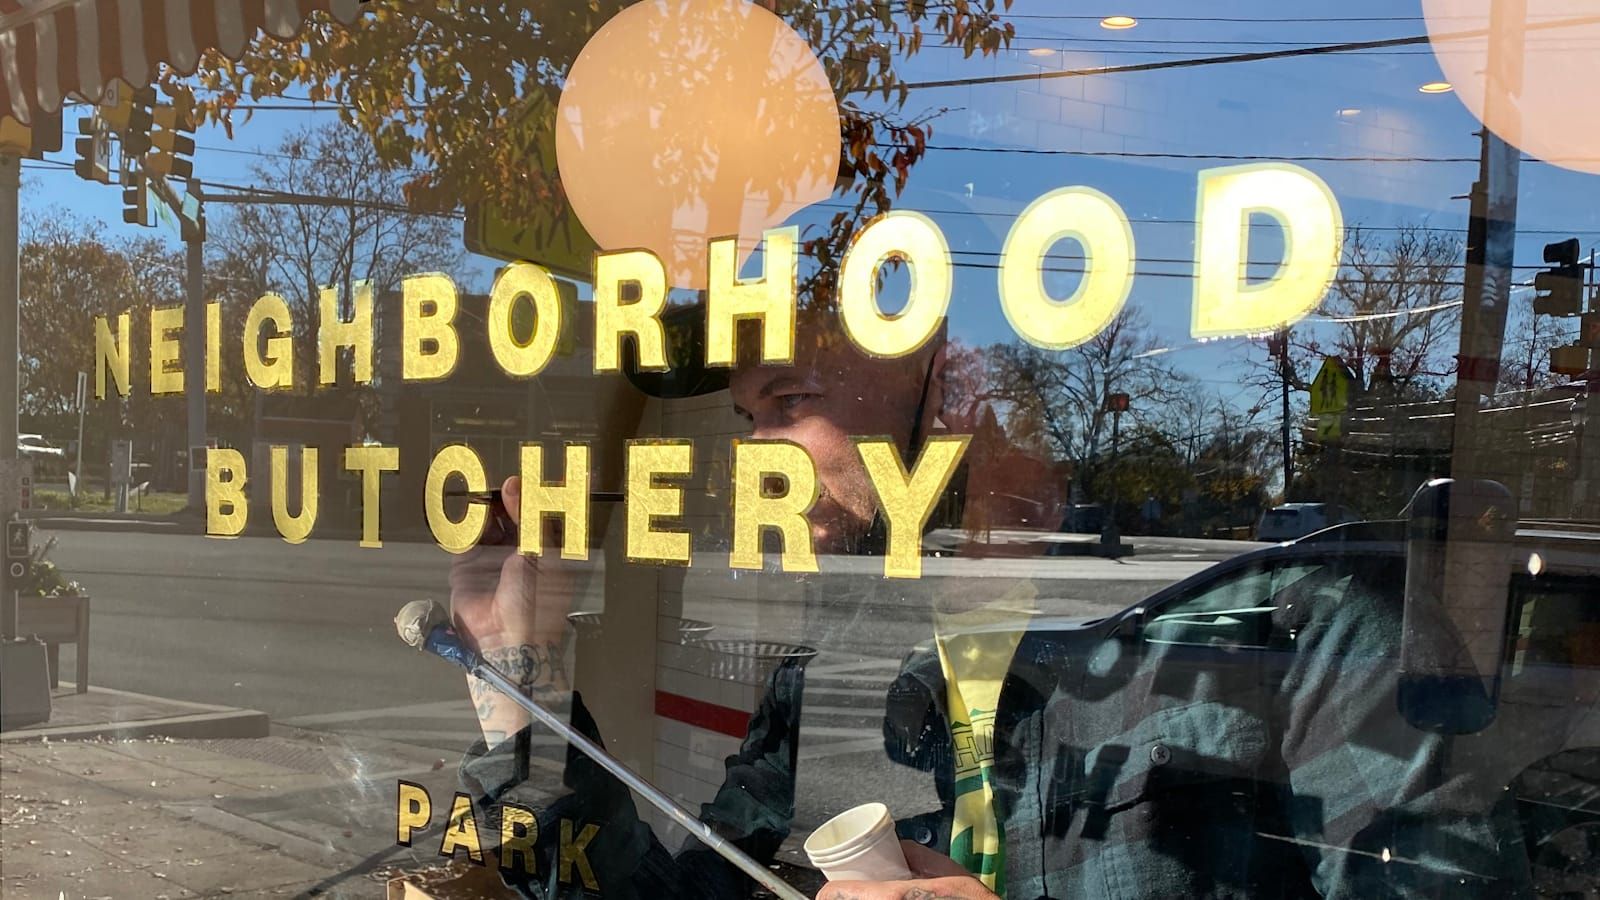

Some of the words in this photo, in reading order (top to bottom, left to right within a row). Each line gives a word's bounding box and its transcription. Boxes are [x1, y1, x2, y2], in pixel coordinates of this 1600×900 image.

[94, 163, 1344, 399] NEIGHBORHOOD
[205, 434, 971, 578] BUTCHERY
[397, 780, 601, 893] PARK
